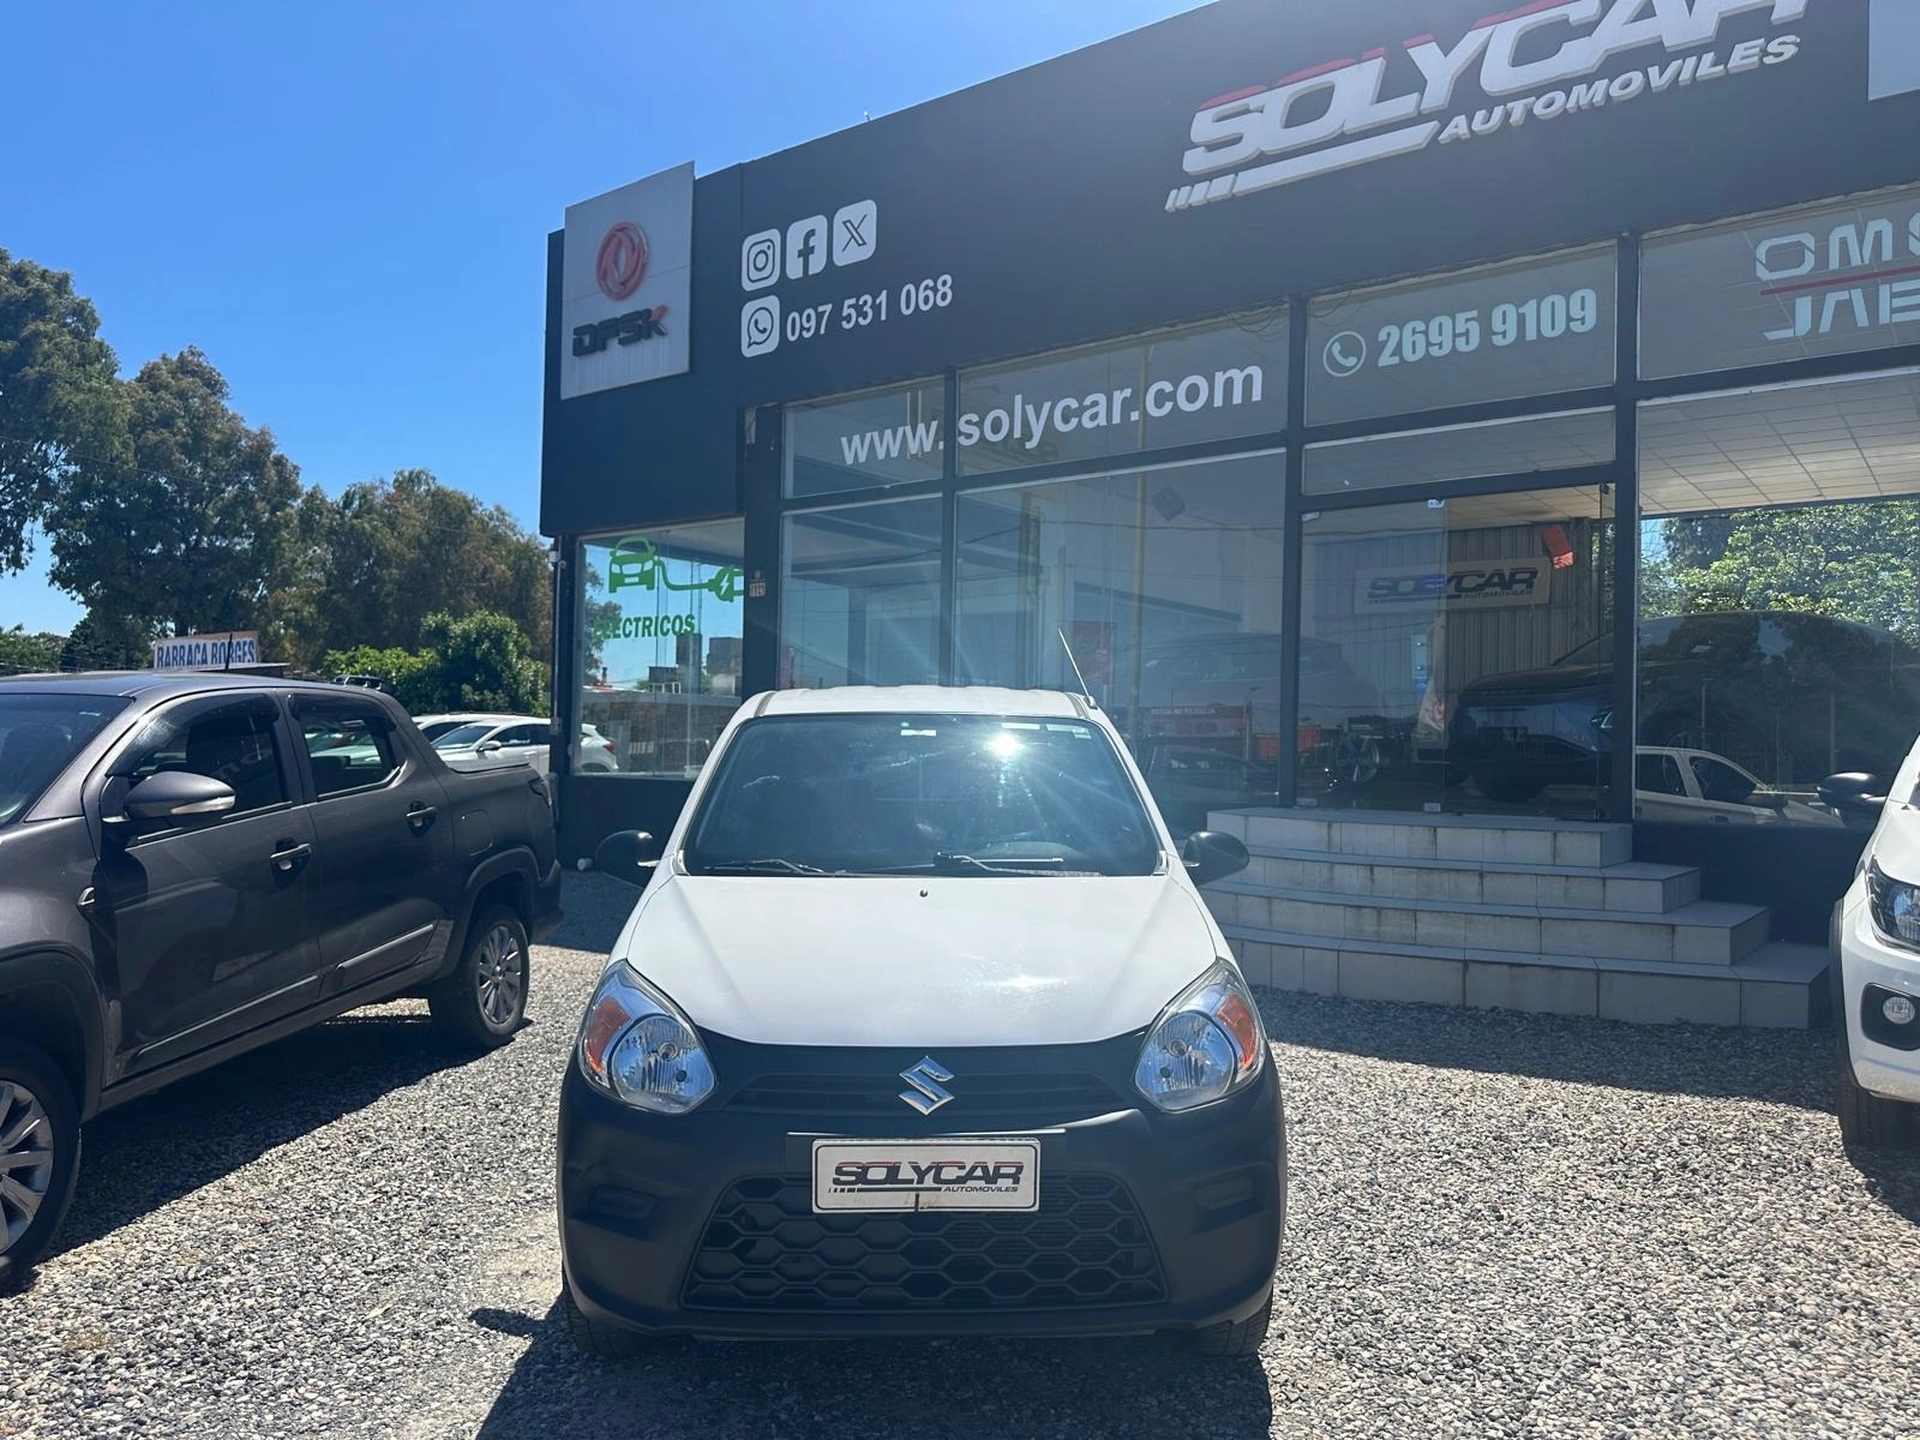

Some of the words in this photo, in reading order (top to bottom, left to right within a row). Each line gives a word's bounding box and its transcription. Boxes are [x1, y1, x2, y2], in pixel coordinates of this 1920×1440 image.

[1438, 35, 1800, 144] AUTOMOVILES
[572, 305, 669, 357] DFSK
[786, 303, 833, 342] 097
[841, 289, 887, 330] 531
[900, 274, 953, 316] 068
[1377, 309, 1481, 367] 2695
[1491, 288, 1598, 347] 9109
[832, 1161, 1025, 1187] SOLYCAR
[942, 1185, 1019, 1193] AUTOMOVILES
